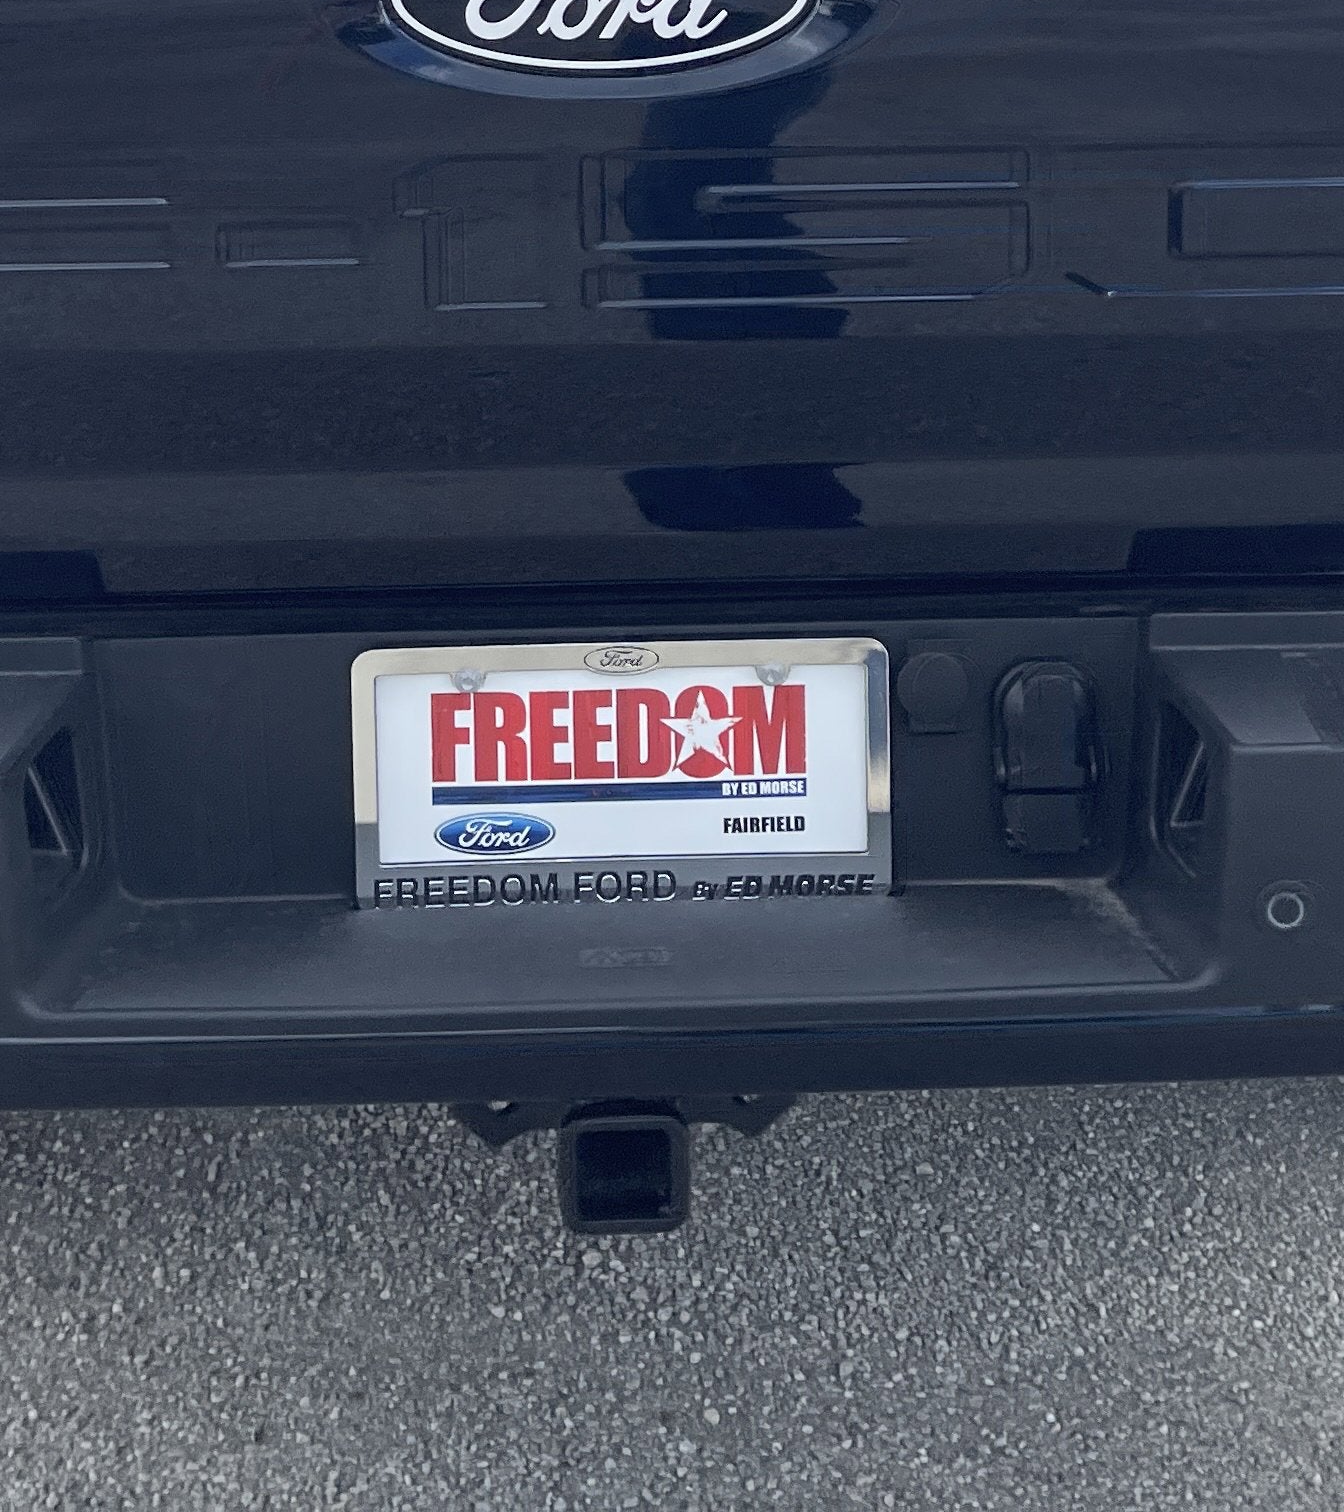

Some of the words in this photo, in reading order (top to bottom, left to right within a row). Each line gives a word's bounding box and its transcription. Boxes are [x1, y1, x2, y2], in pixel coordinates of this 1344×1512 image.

[600, 650, 643, 667] Ford
[431, 685, 806, 780] FREEDOM
[722, 782, 738, 796] BY
[741, 781, 757, 795] ED
[759, 780, 805, 795] MORSE
[458, 818, 531, 847] Ford
[723, 816, 805, 833] FAIRFIELD
[374, 872, 559, 909] FREEDOM
[574, 870, 677, 903] FORD
[723, 875, 762, 900] ED
[767, 873, 875, 897] MORSE
